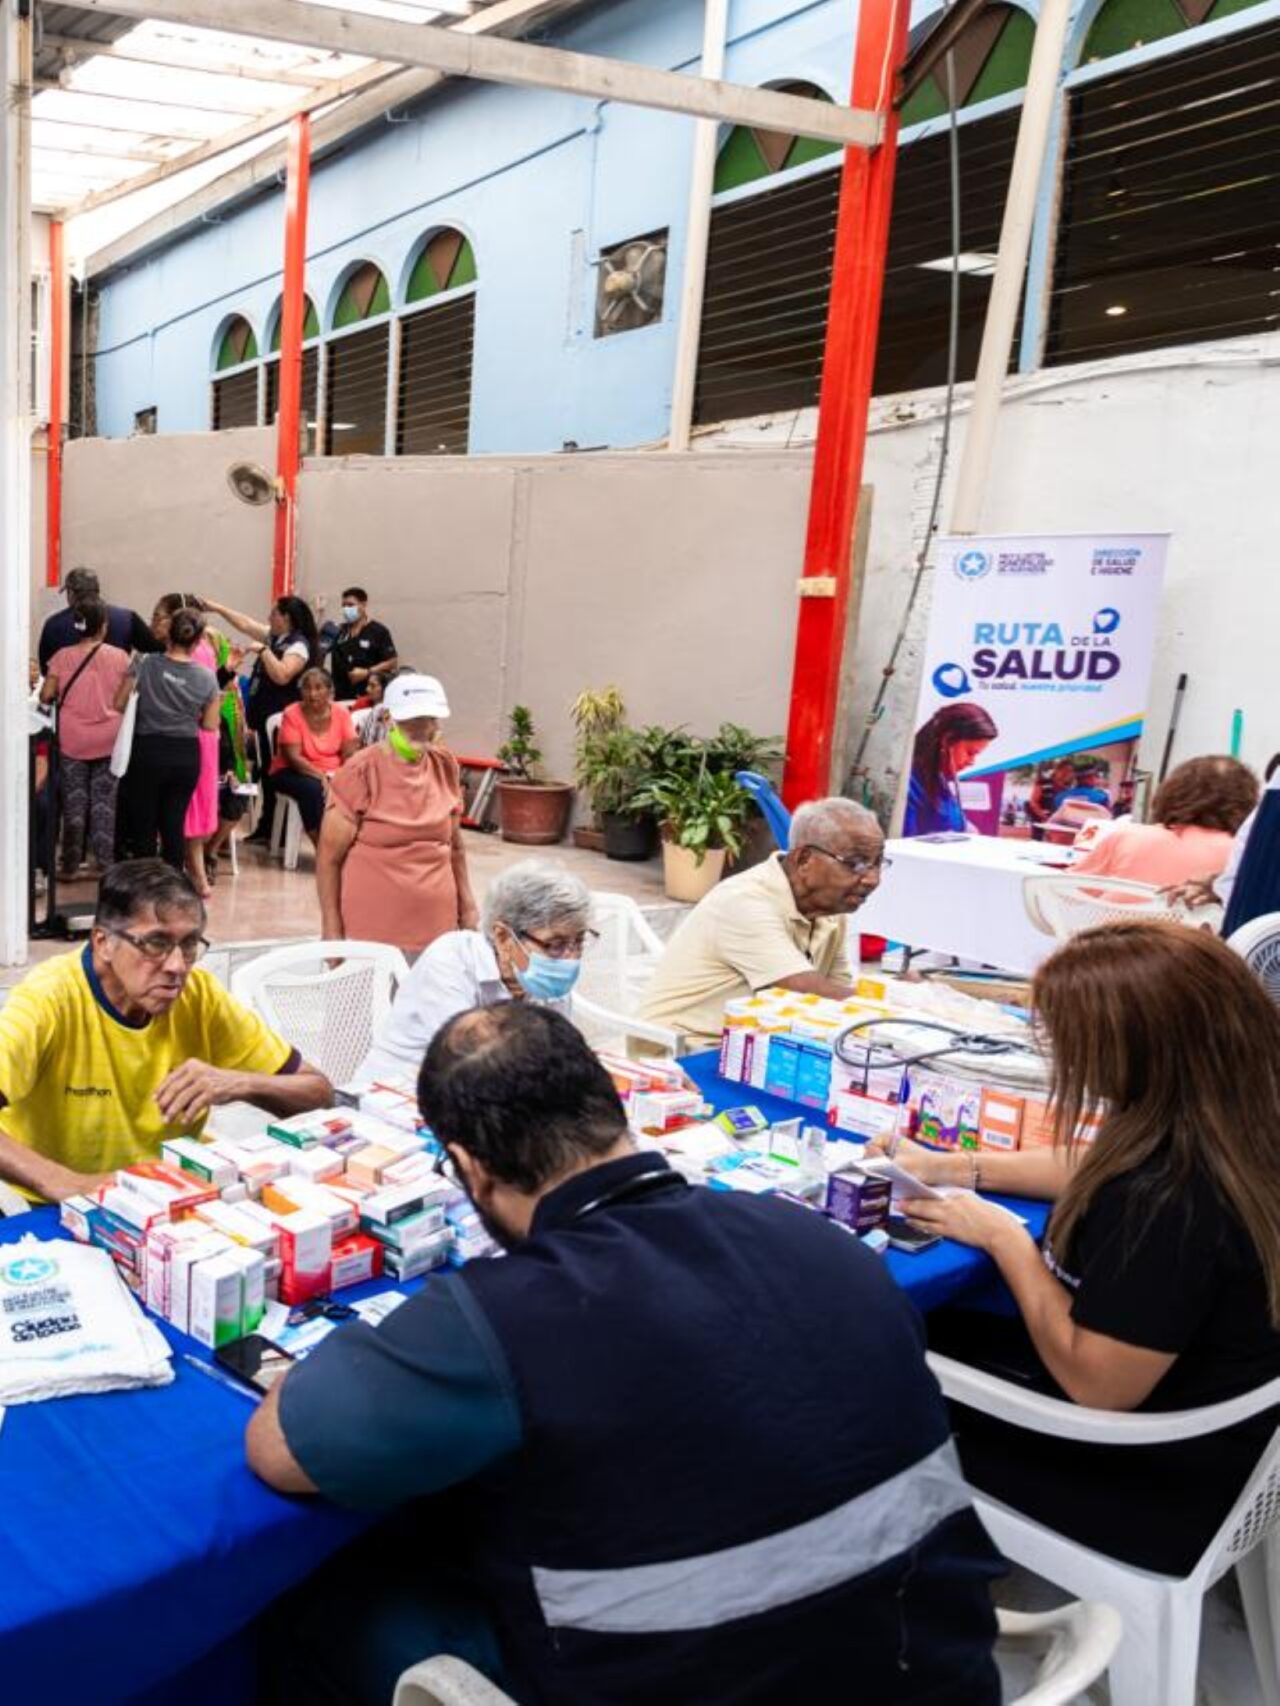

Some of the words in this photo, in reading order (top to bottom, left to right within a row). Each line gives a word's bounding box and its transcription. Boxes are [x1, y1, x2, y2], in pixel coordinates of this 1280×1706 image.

[1092, 558, 1103, 567] DE
[1105, 558, 1137, 567] SALUD
[974, 622, 1064, 646] RUTA
[1070, 636, 1090, 647] DE
[1093, 636, 1111, 647] LA
[971, 648, 1122, 681] SALUD
[11, 1313, 78, 1334] Ciudad
[13, 1331, 35, 1342] de
[35, 1322, 82, 1339] todos
